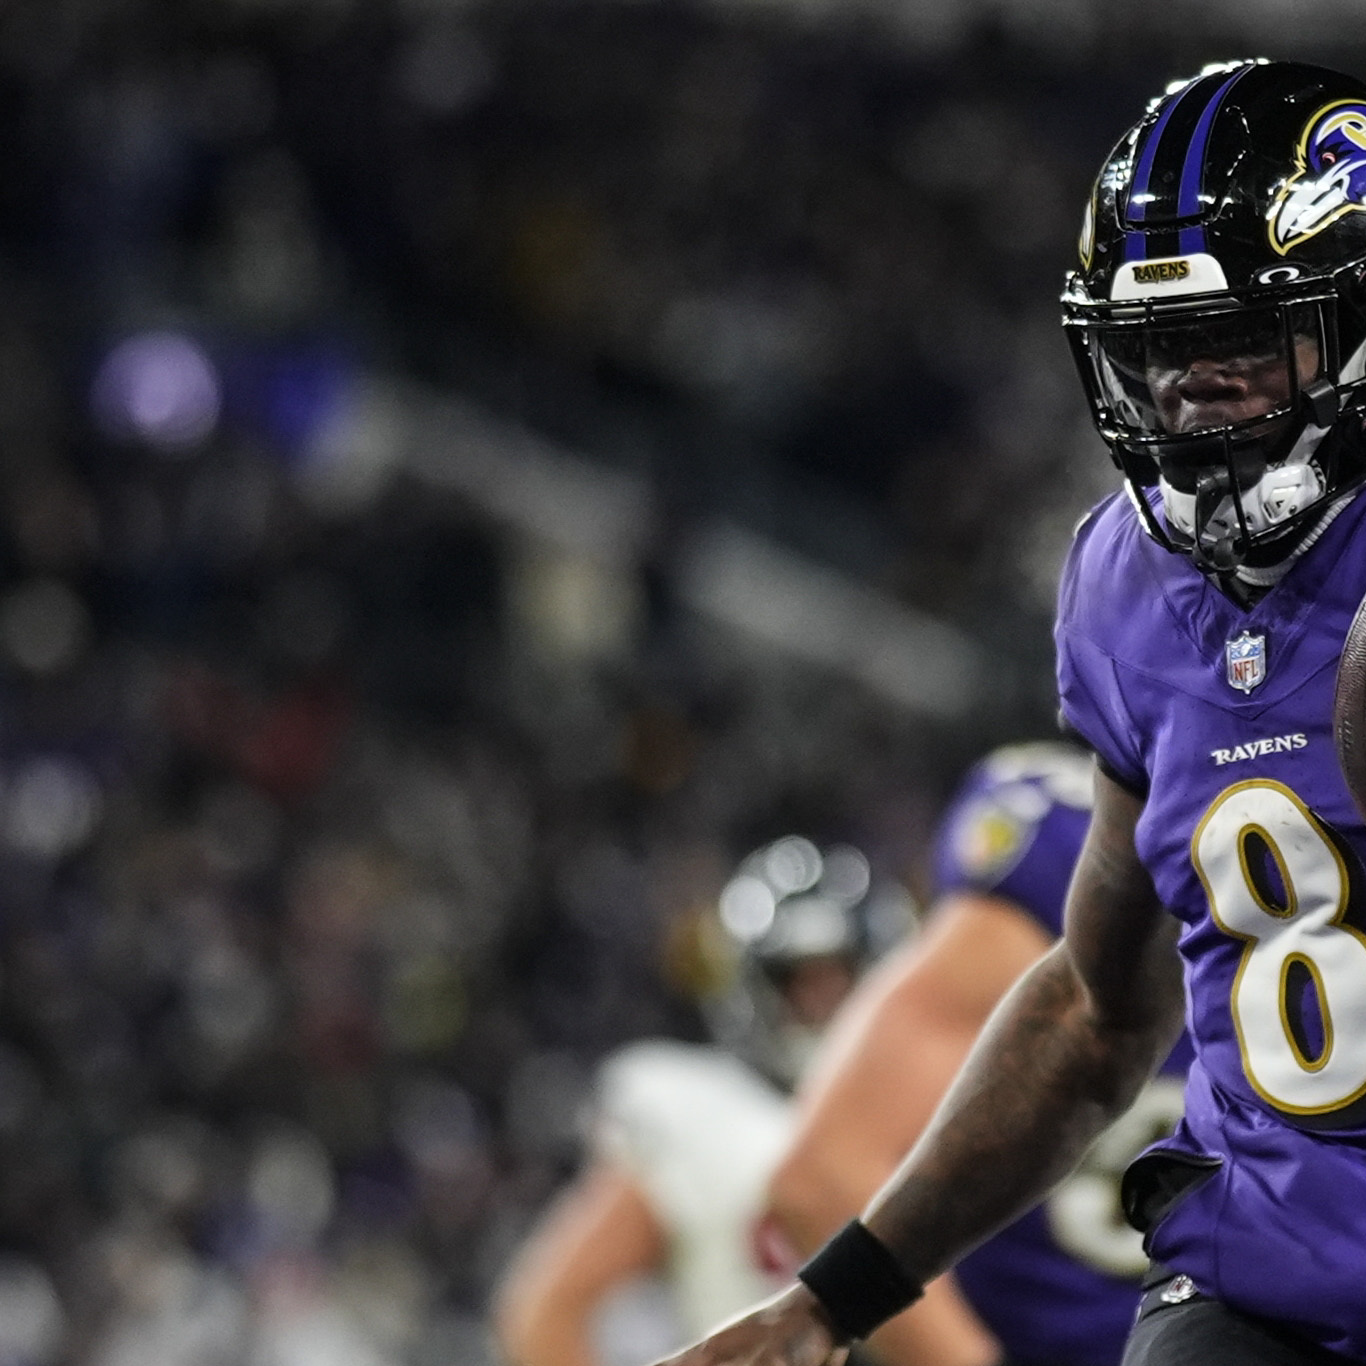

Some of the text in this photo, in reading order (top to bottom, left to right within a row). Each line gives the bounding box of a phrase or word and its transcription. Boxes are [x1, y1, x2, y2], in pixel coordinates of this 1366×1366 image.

[1132, 260, 1190, 284] RAVENS
[1233, 660, 1259, 682] NFL
[1210, 733, 1308, 766] RAVENS
